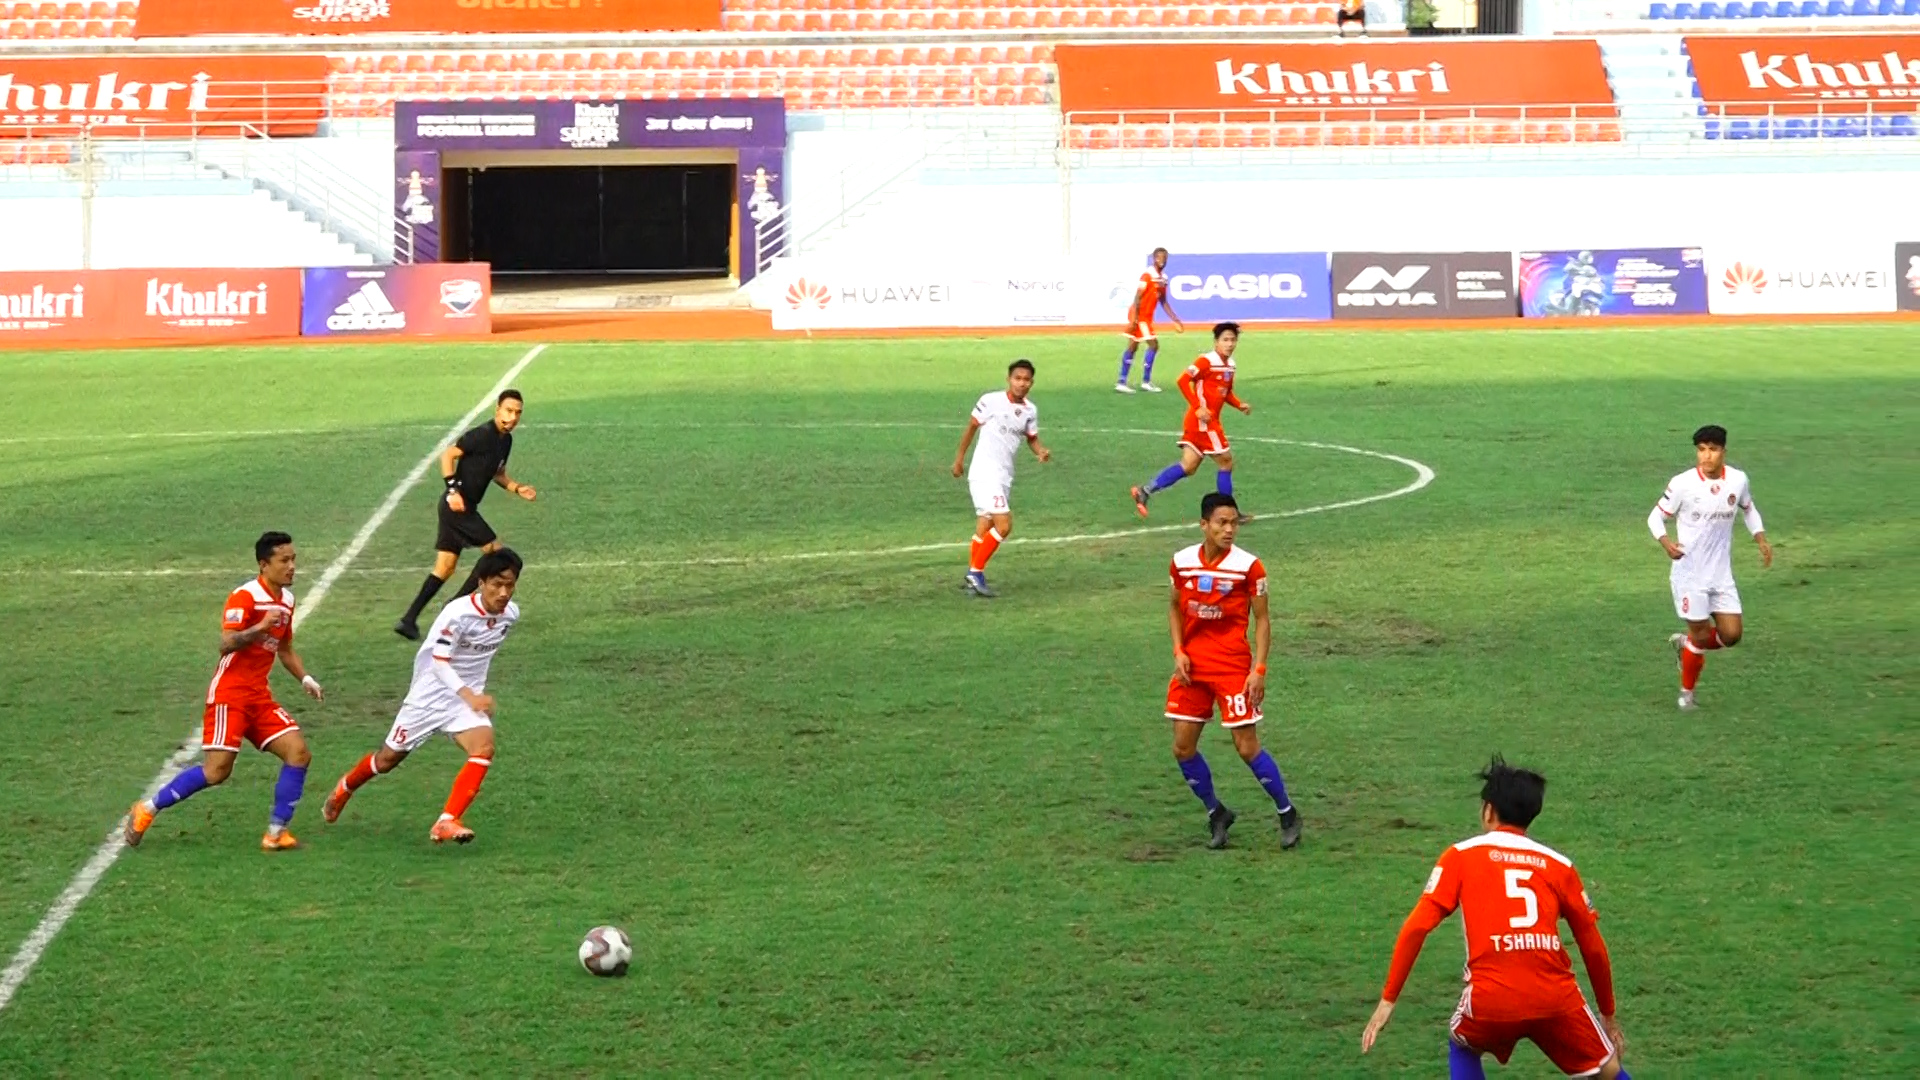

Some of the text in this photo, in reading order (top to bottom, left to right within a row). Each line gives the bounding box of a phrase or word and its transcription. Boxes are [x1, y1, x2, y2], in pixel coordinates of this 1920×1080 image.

[292, 7, 390, 18] SUPER
[1215, 58, 1450, 94] Khukri
[417, 125, 483, 136] FOOTBALL
[559, 127, 619, 142] SUPER
[1007, 279, 1065, 292] Norvic
[1777, 271, 1887, 288] HUAWEI
[0, 283, 84, 318] ukri
[145, 277, 268, 316] Khukri
[841, 285, 950, 304] HUAWEI
[1337, 292, 1438, 306] NIVIA
[326, 311, 407, 331] adidas
[993, 495, 1007, 508] 23
[1681, 597, 1690, 614] 8
[392, 725, 408, 744] 15
[1502, 853, 1547, 869] YAMAHA
[1503, 869, 1539, 929] 5
[1489, 933, 1561, 952] TSHRING
